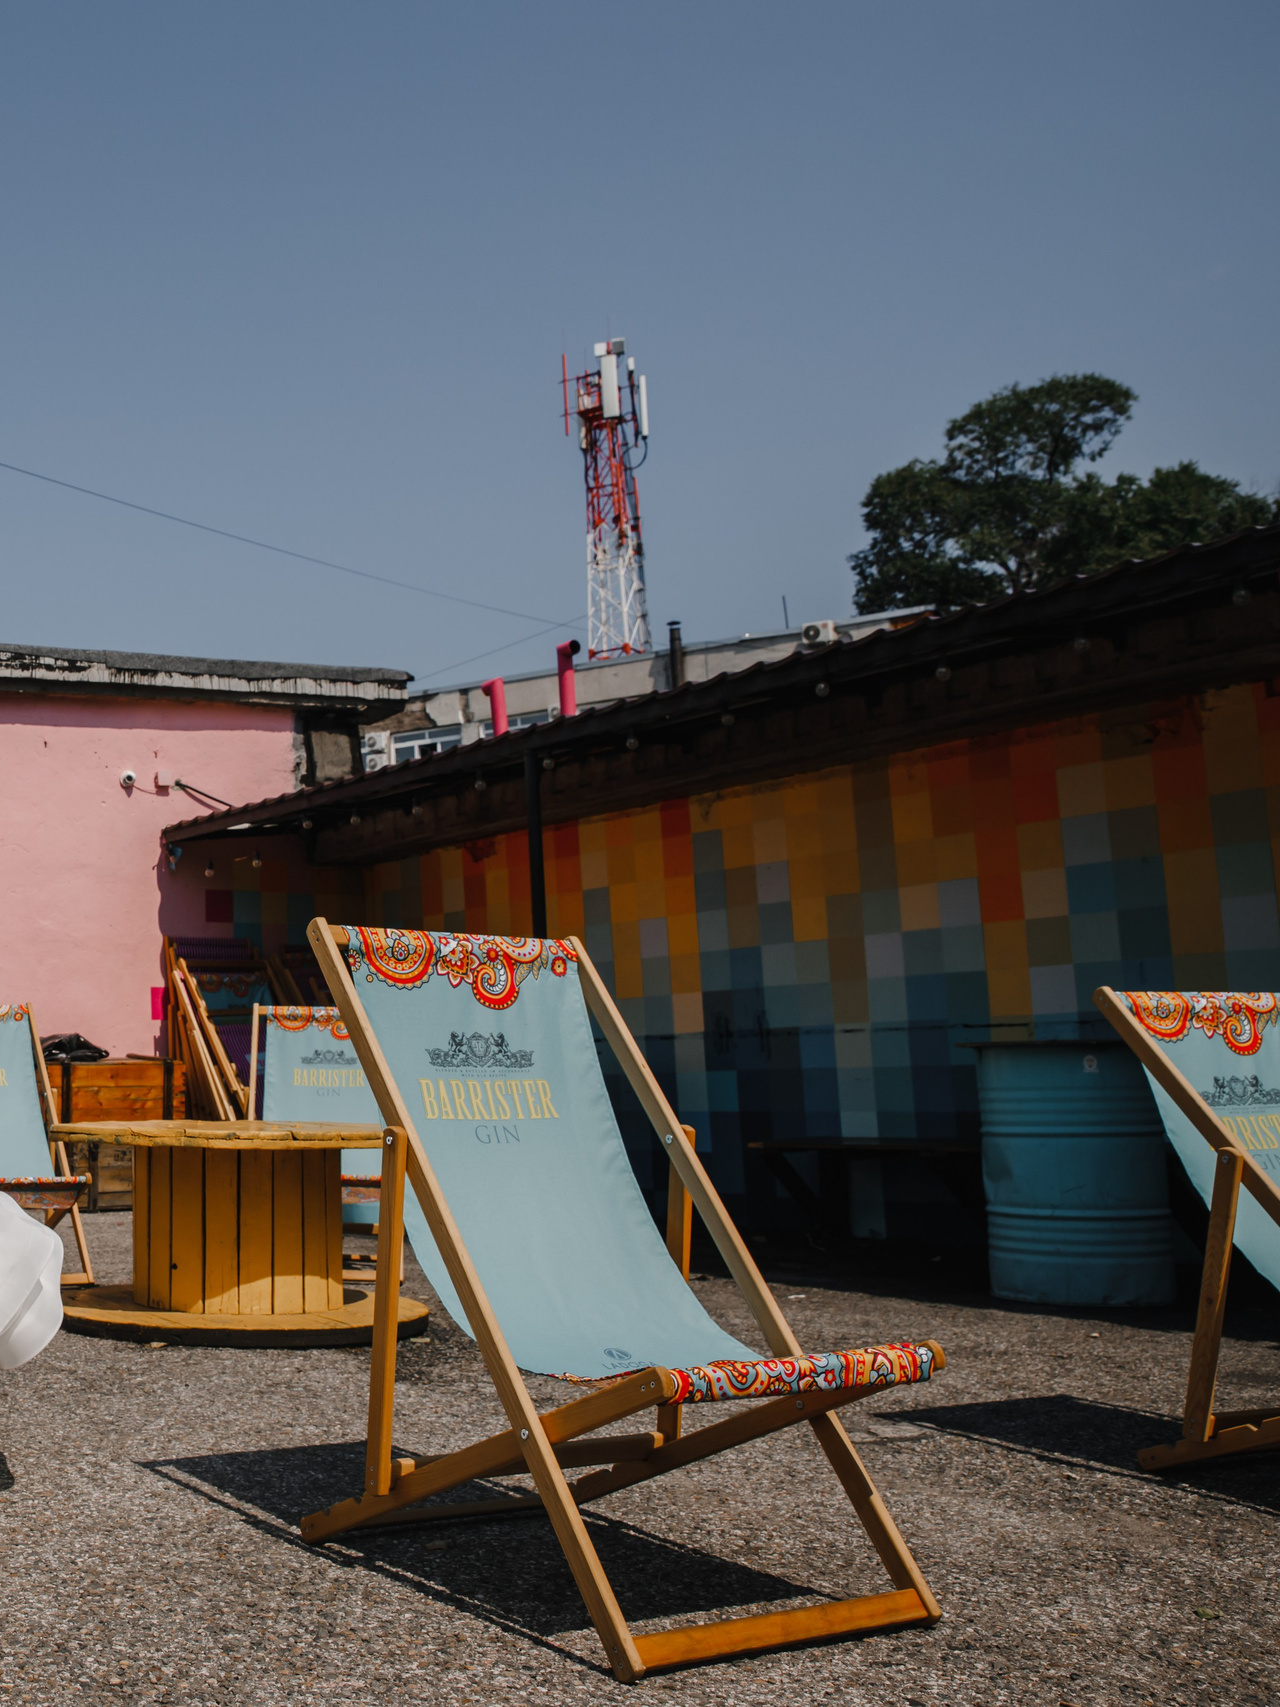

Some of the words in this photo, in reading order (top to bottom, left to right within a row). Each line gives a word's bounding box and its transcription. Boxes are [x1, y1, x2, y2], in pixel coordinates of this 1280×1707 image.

[293, 1069, 365, 1087] BARRISTER
[317, 1088, 340, 1096] GIN
[418, 1078, 559, 1120] BARRISTER
[474, 1125, 521, 1145] GIN
[602, 1361, 659, 1370] LADOGA
